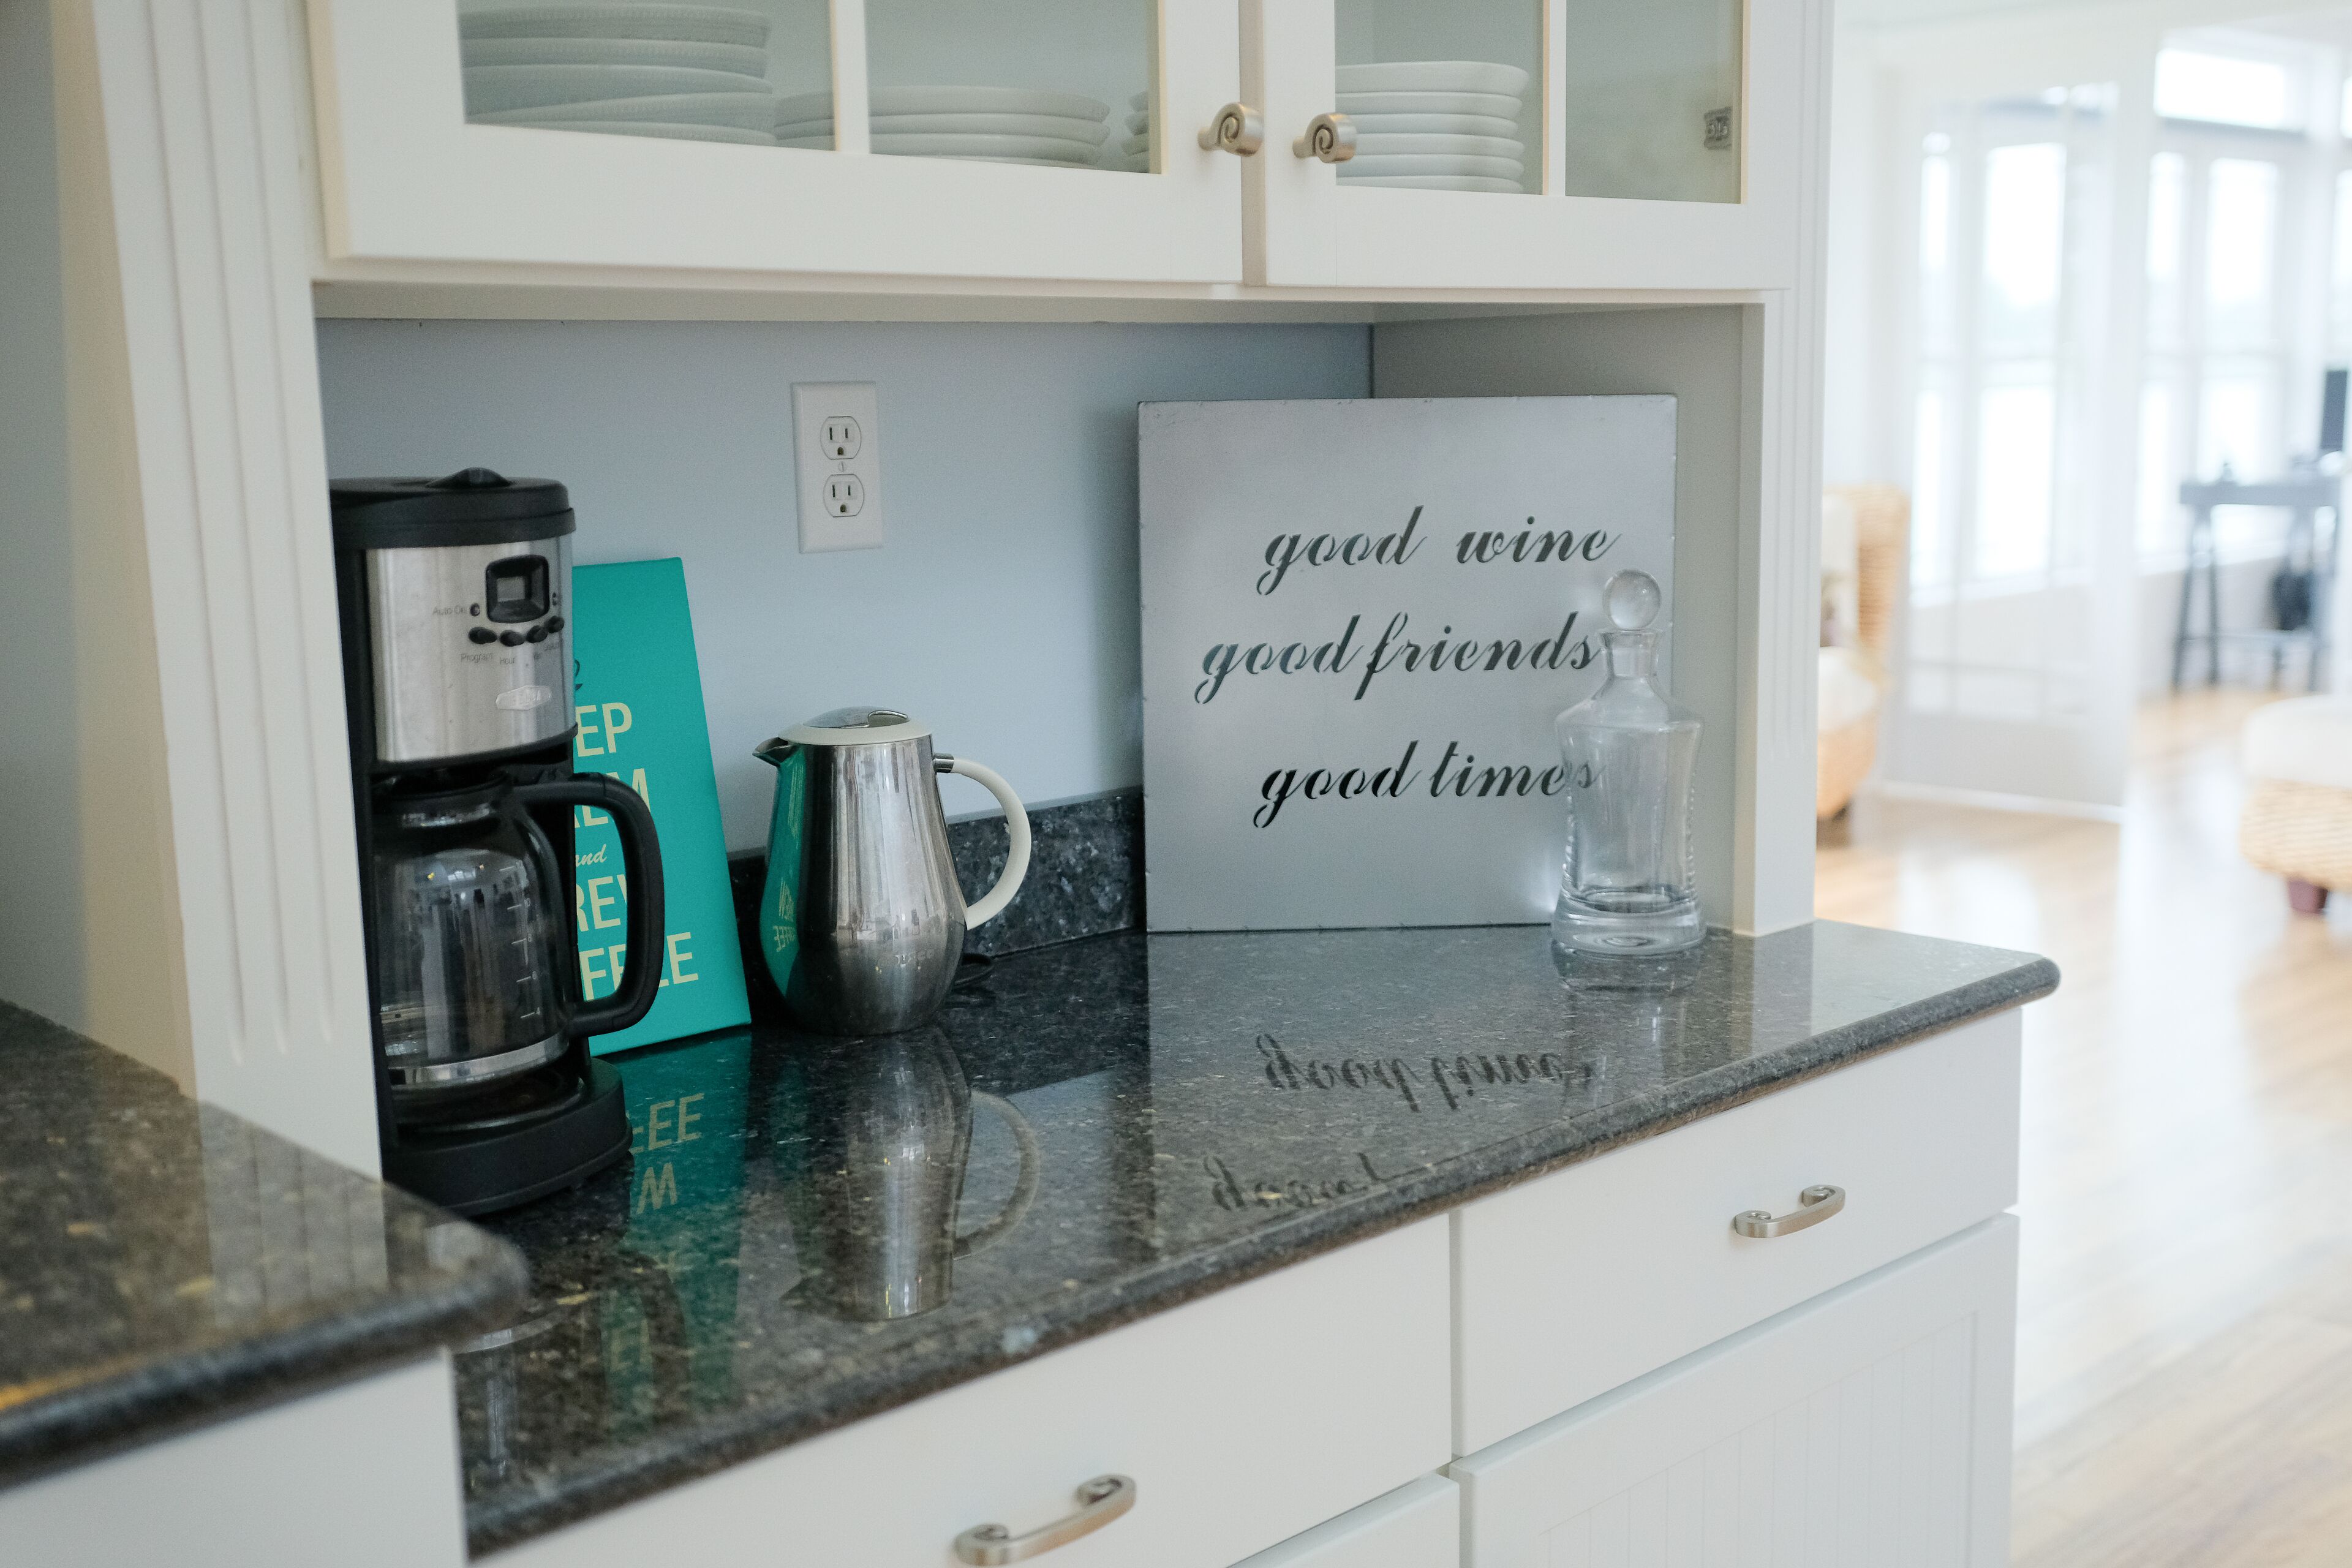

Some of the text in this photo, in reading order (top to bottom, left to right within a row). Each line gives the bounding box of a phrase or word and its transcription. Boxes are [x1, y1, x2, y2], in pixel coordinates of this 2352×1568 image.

[1257, 505, 1623, 595] good wine
[1194, 611, 1600, 704] good friends
[575, 702, 632, 757] EP
[1253, 741, 1606, 828] good times
